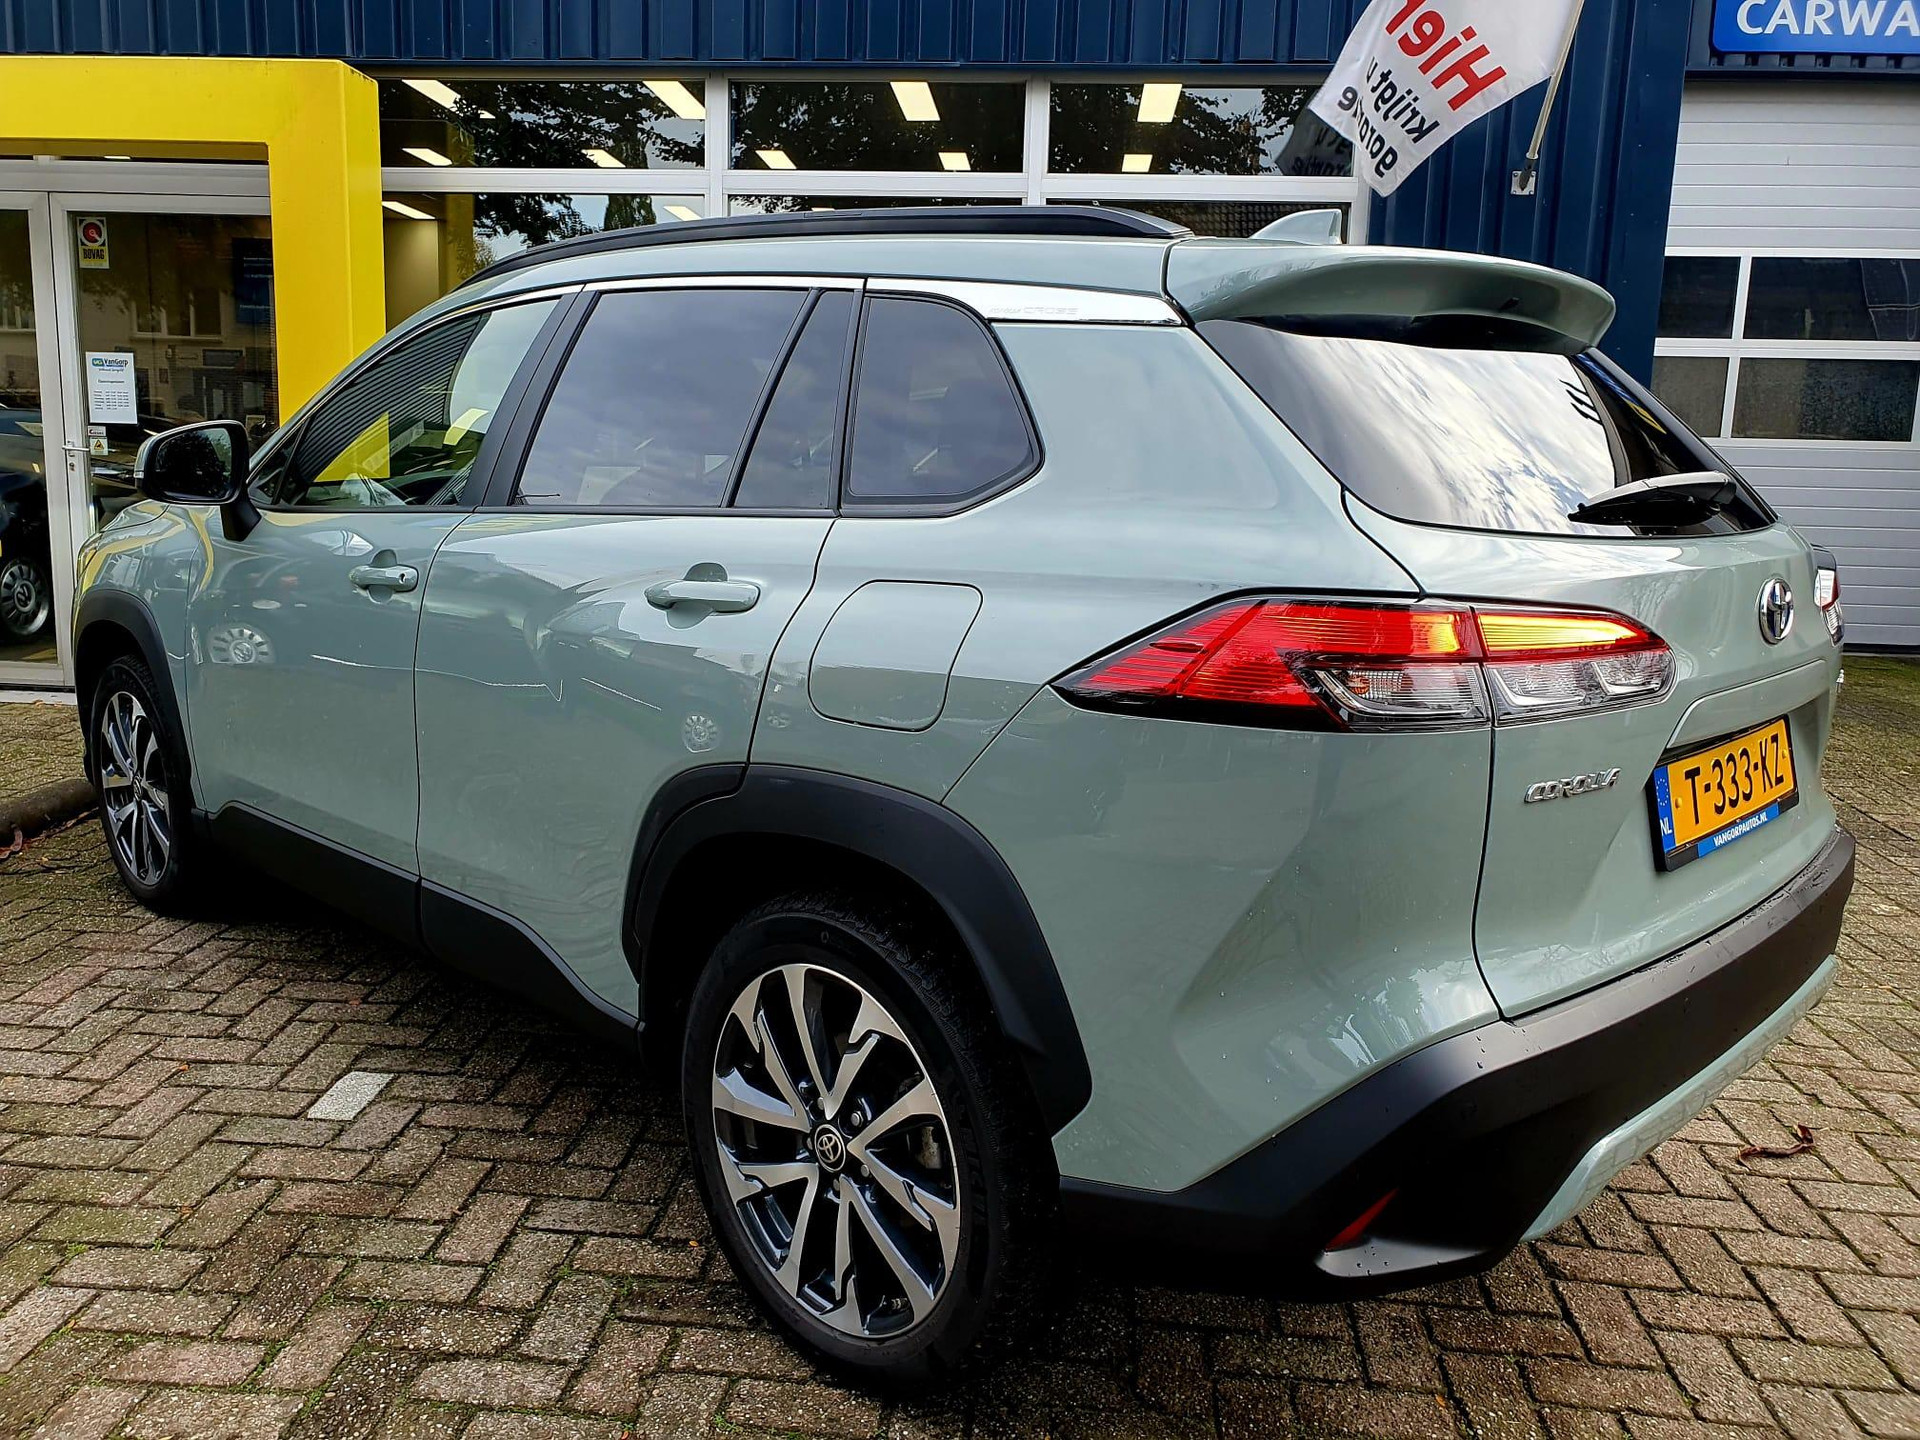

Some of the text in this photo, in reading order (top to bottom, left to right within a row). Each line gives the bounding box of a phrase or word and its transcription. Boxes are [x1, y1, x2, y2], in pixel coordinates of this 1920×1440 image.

[1736, 0, 1920, 37] CARWA
[83, 248, 105, 260] BOVAG
[103, 358, 129, 368] VanGorp
[1524, 767, 1621, 803] COROLLA
[1684, 733, 1785, 826] T-333-KZ
[1660, 817, 1673, 837] NL
[1713, 811, 1768, 847] VANGORPAUTOS.NL
